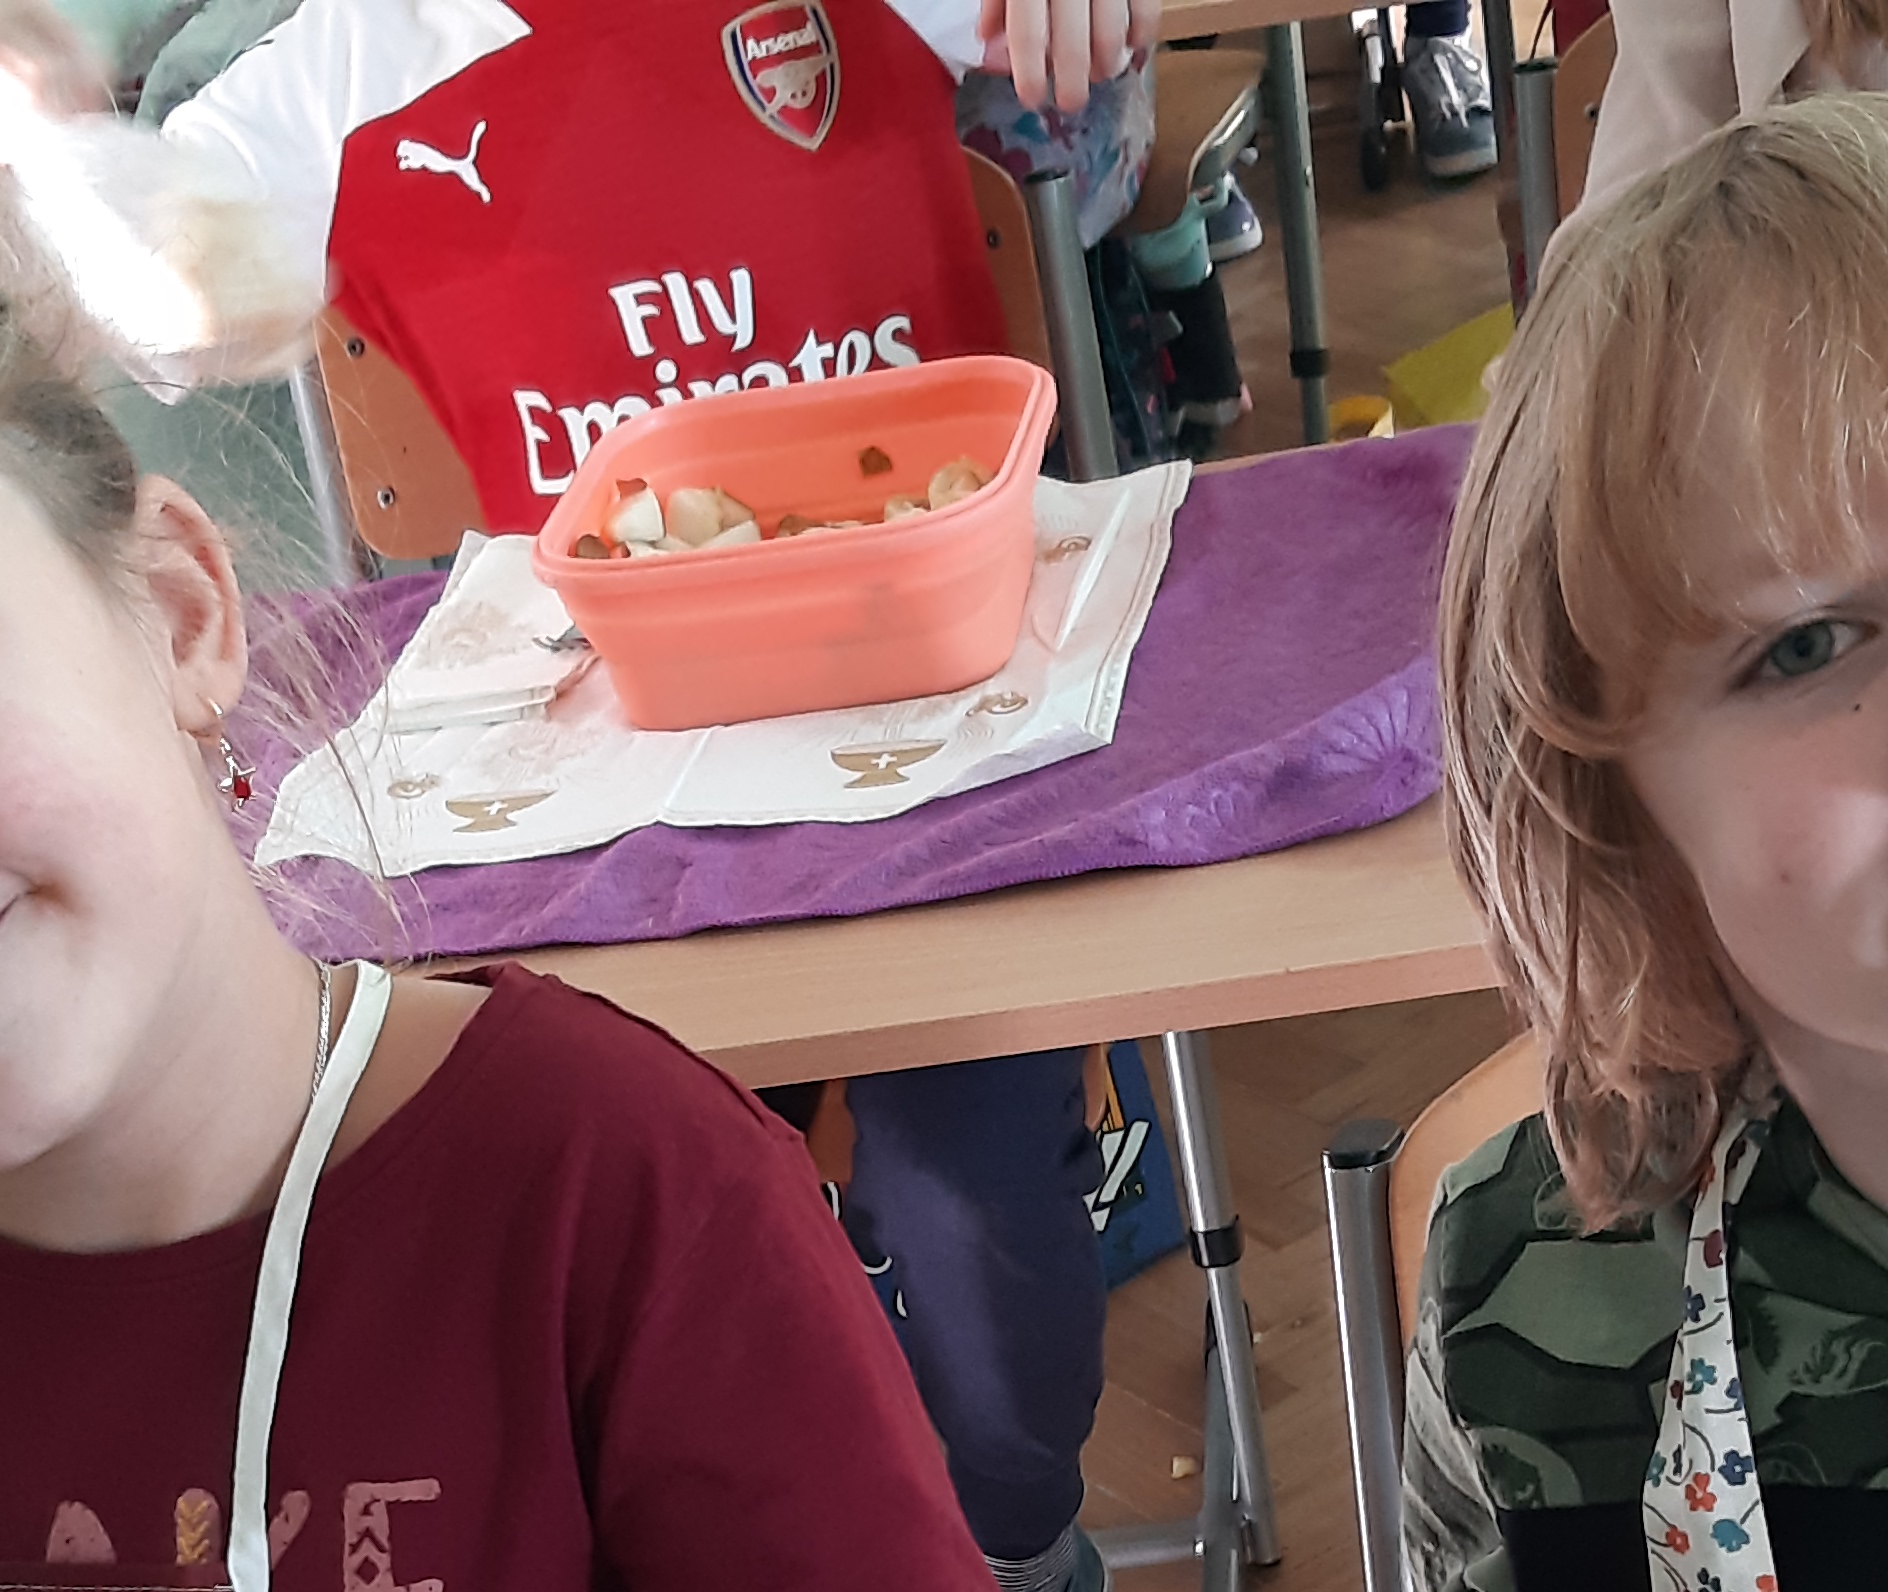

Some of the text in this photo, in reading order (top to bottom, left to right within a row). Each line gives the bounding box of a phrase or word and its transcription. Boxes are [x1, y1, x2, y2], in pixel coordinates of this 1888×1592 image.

[745, 19, 817, 61] Arsenal
[608, 265, 757, 358] Fly
[512, 313, 923, 497] Emtes
